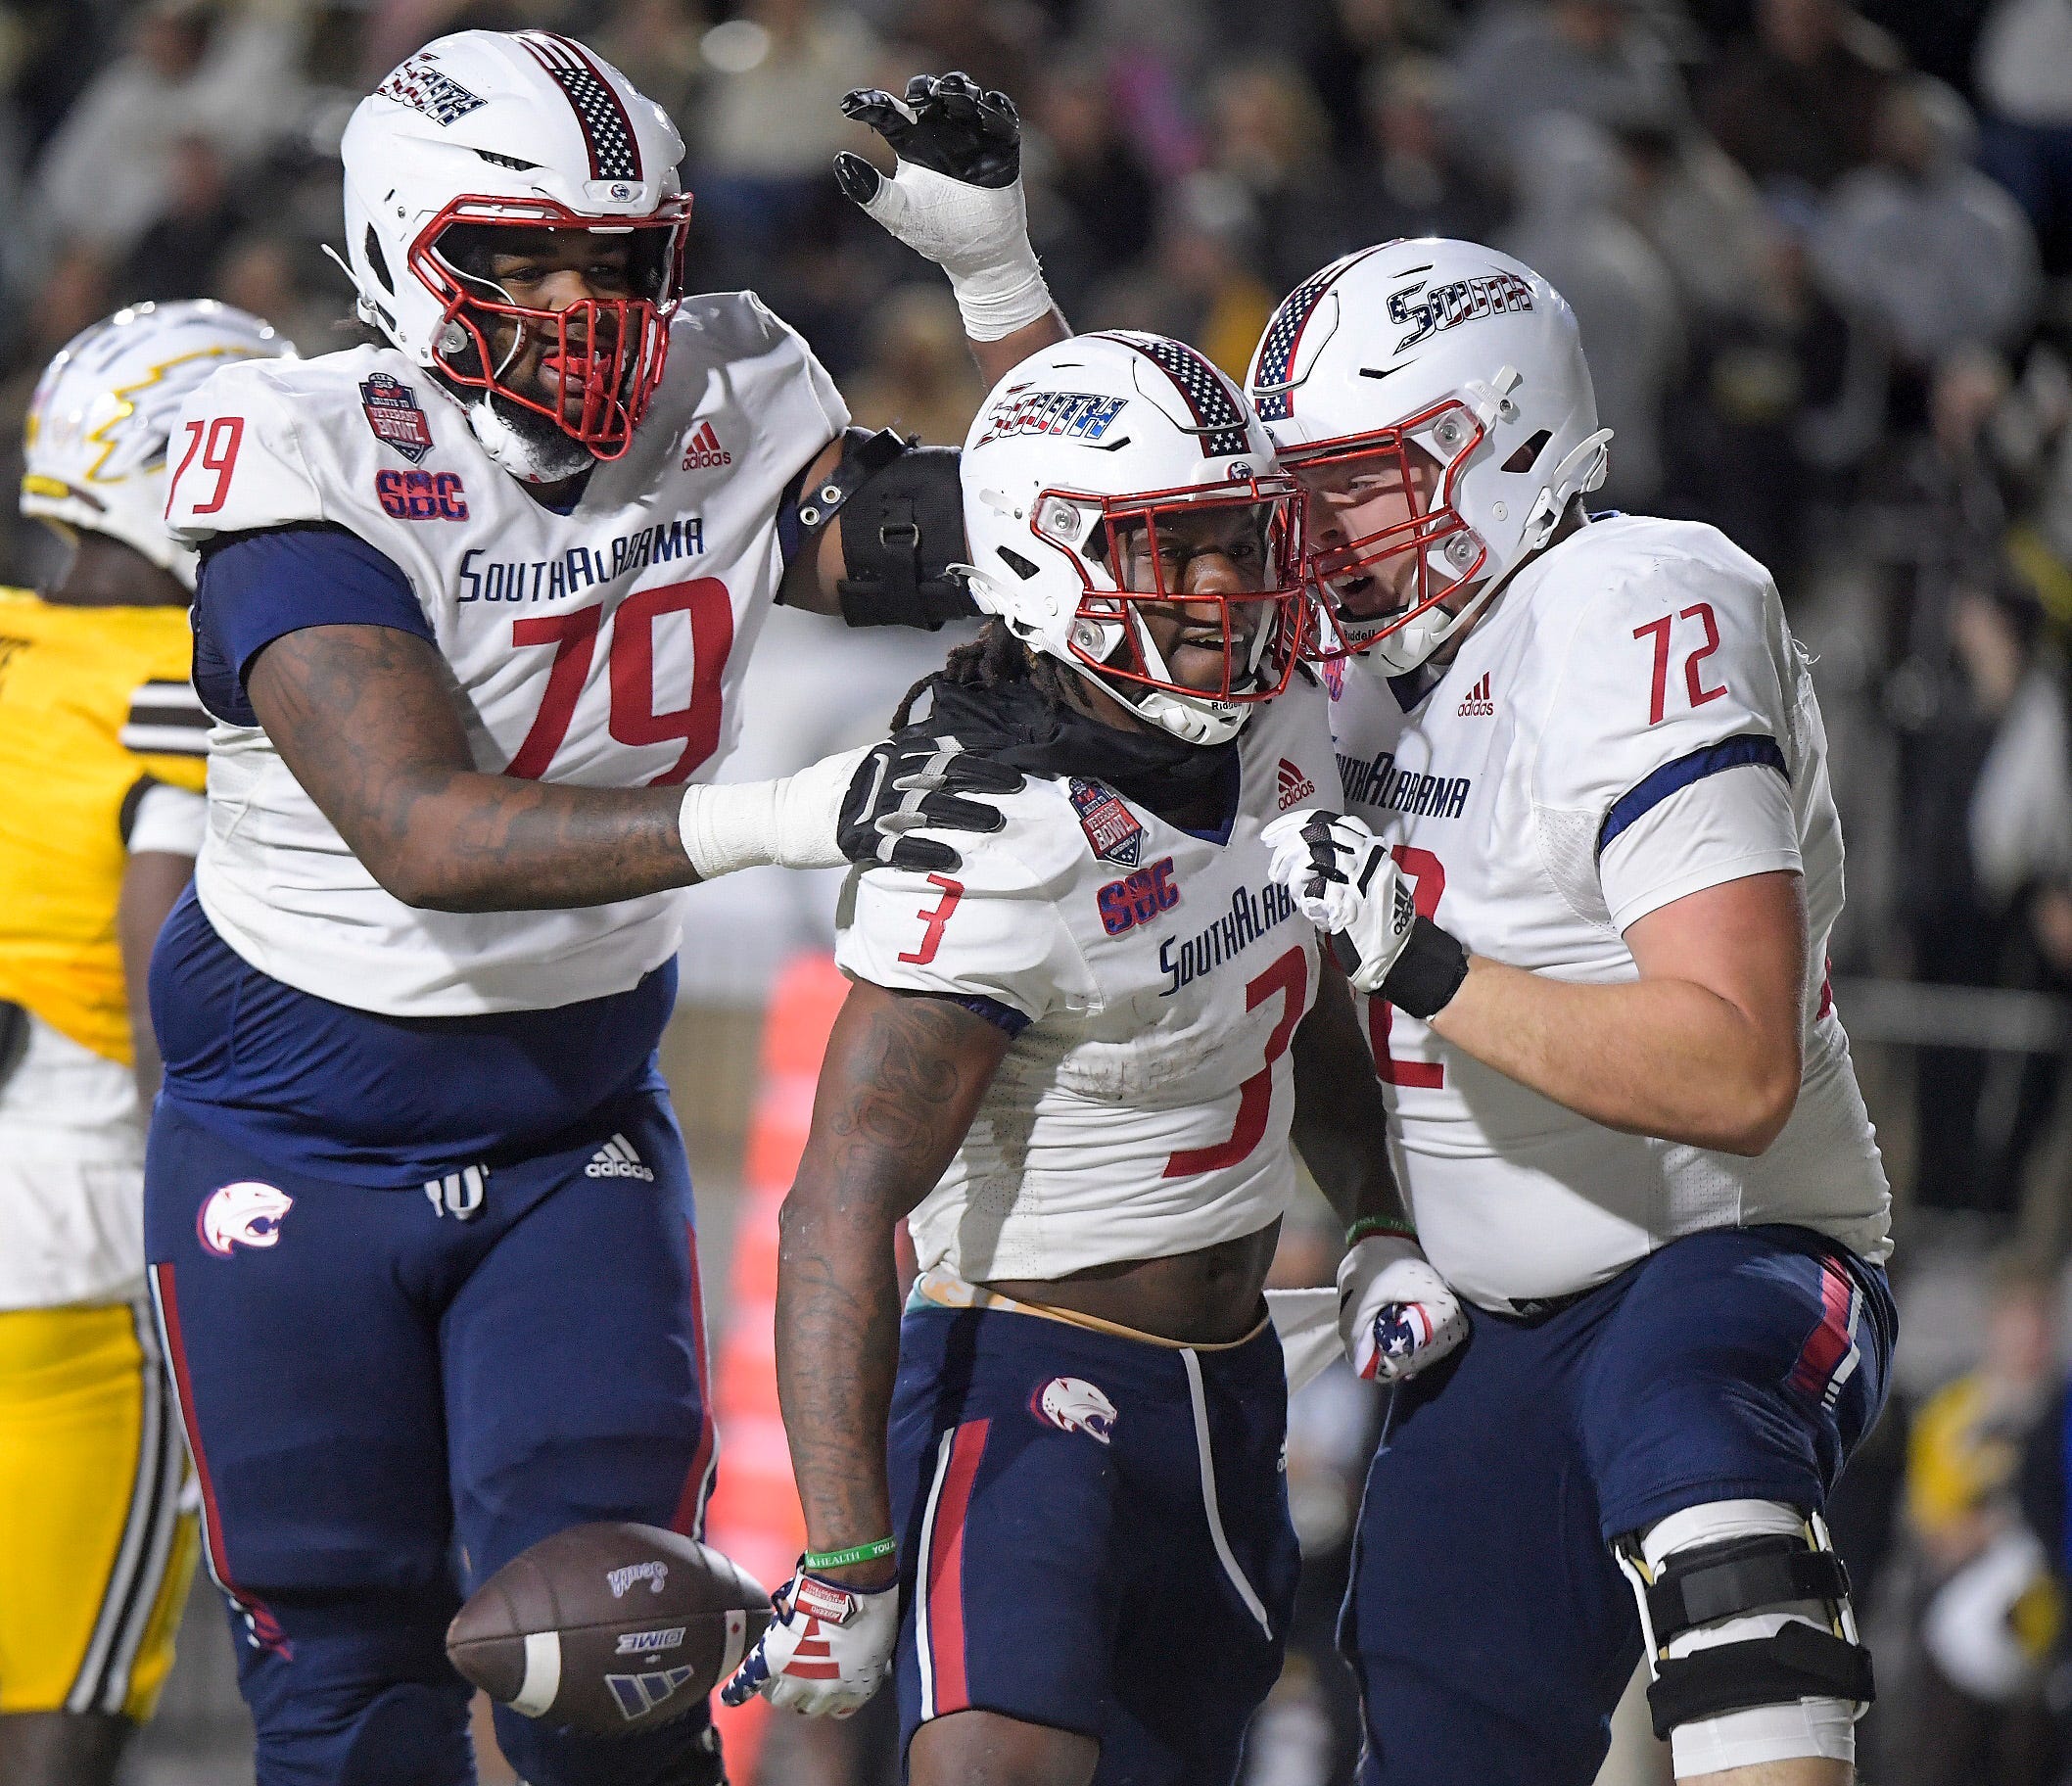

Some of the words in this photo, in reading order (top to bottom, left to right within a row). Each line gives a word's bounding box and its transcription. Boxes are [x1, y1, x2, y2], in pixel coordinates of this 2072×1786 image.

[368, 406, 419, 424] VETERANS
[373, 417, 426, 443] BOWL
[973, 382, 1130, 450] SOUTH
[165, 416, 245, 521] 79
[683, 451, 731, 472] adidas
[375, 469, 470, 522] SBC
[502, 576, 734, 787] 79
[1633, 602, 1728, 726] 72
[1458, 699, 1494, 718] adidas
[1278, 780, 1315, 812] adidas
[1085, 802, 1121, 831] VETERANS
[1092, 815, 1135, 852] BOWL
[1097, 856, 1180, 936] SBC
[897, 872, 965, 965] 3
[1162, 945, 1308, 1179] 3
[585, 1159, 655, 1183] adidas
[817, 1551, 860, 1567] HEALTH
[606, 1560, 669, 1599] South
[614, 1626, 686, 1656] DIME
